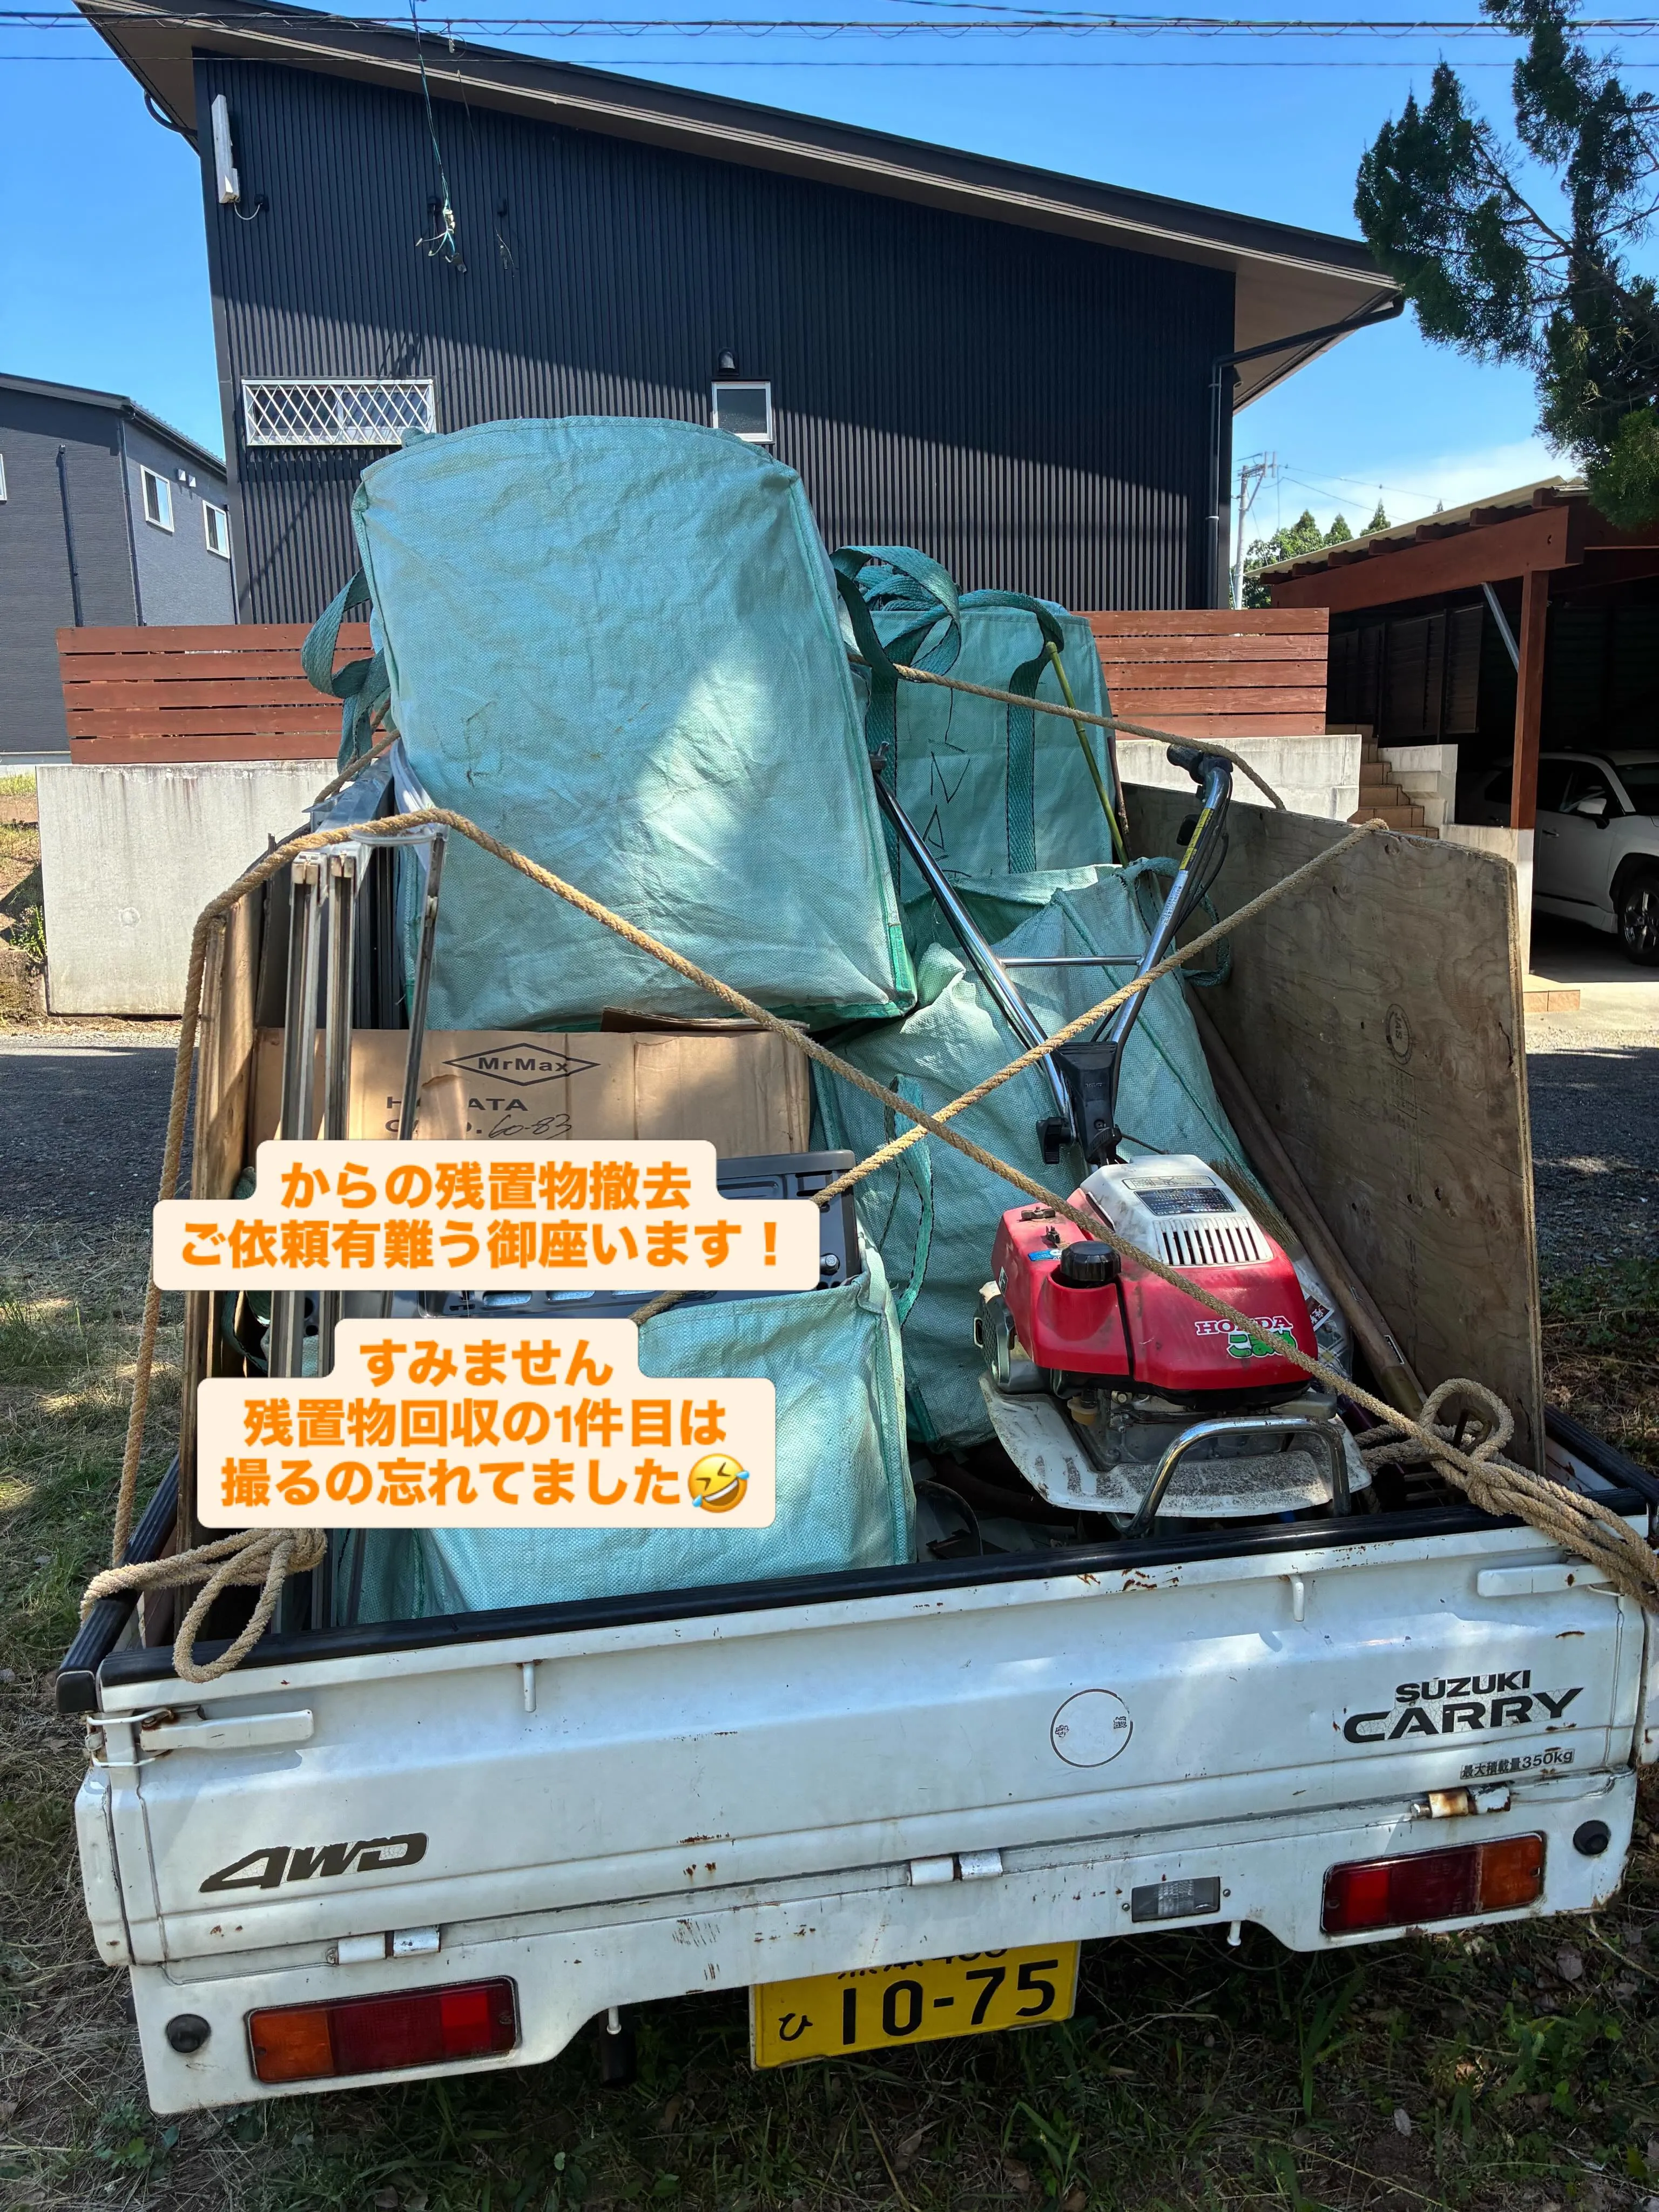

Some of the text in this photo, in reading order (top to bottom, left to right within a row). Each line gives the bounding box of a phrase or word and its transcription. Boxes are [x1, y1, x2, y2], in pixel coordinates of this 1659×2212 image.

[478, 1057, 568, 1073] MrMax
[1196, 1316, 1293, 1334] HODA
[1395, 1669, 1531, 1703] SUZUKI
[1343, 1687, 1584, 1744] CARRY
[199, 1832, 428, 1893] 4WD
[778, 2012, 813, 2042] ひ
[842, 1959, 1058, 2045] 10-75
